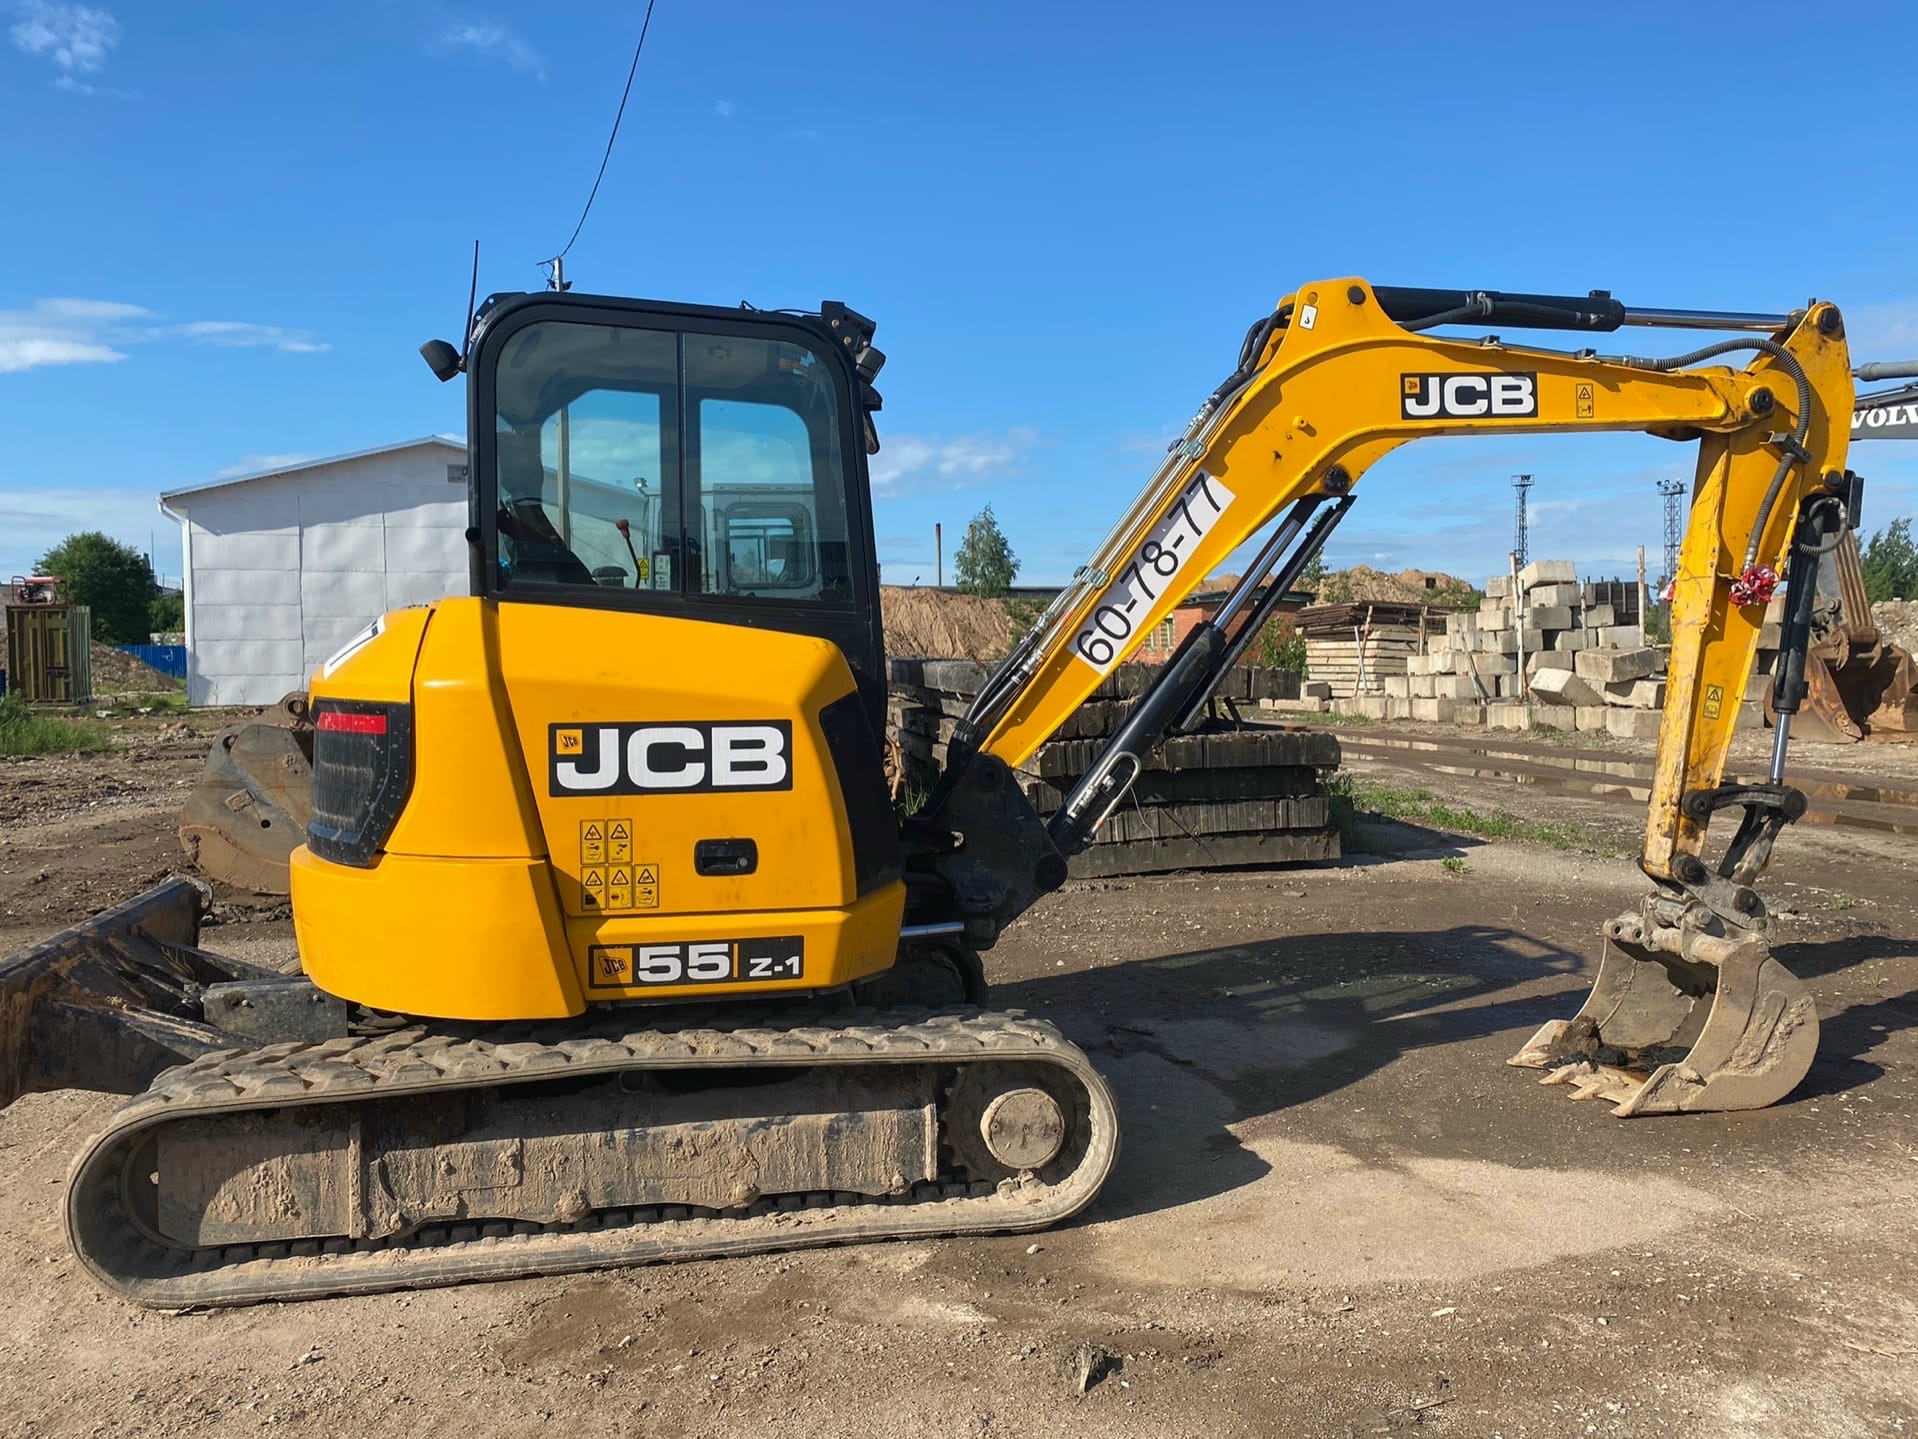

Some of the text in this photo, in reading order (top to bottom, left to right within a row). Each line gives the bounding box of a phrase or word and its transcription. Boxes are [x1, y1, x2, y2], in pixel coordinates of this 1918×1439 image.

[1404, 375, 1535, 417] JCB
[1076, 471, 1221, 665] 60-78-77
[556, 726, 787, 790] JCB
[602, 943, 800, 983] JCB 55 Z-1
